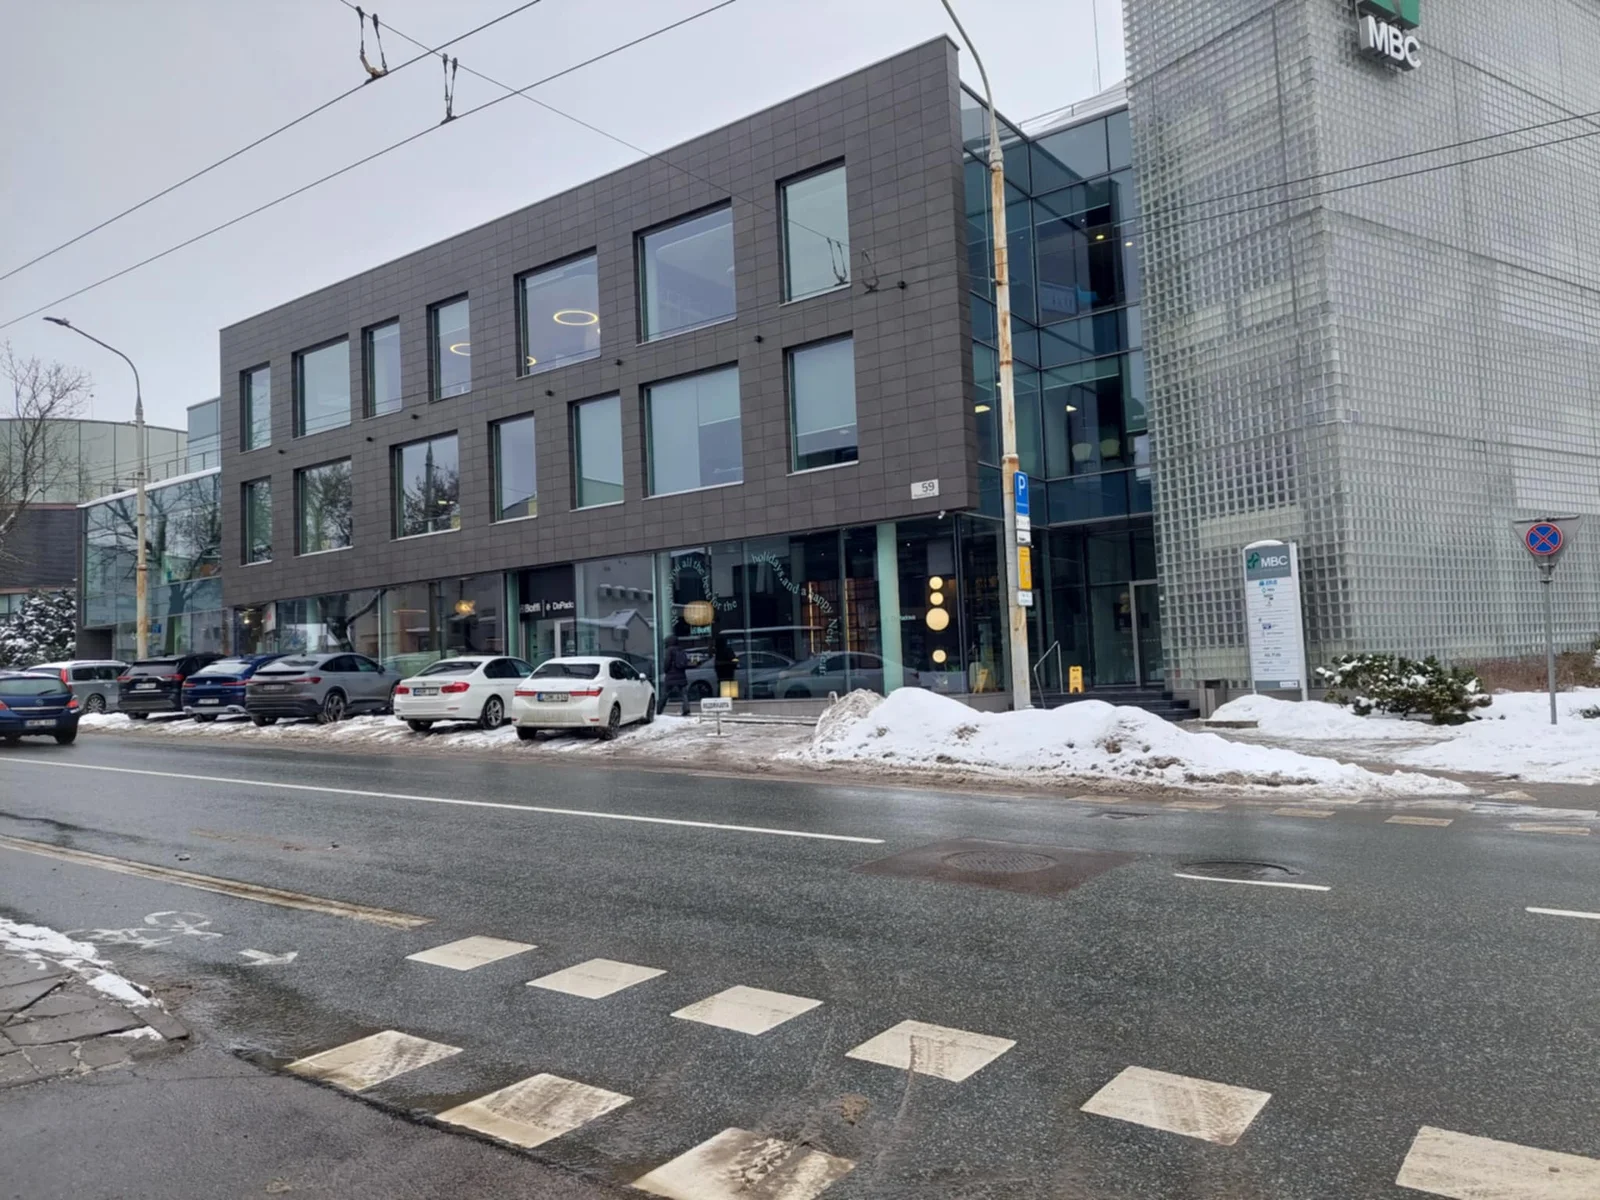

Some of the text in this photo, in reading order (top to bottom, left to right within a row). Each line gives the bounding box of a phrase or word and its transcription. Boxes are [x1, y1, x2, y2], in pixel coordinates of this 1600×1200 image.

[1367, 15, 1422, 68] MBC
[921, 481, 935, 493] 59
[1018, 475, 1026, 496] P
[1261, 555, 1288, 568] MBC
[682, 557, 692, 568] all
[693, 560, 705, 575] the
[702, 575, 713, 600] best
[724, 600, 738, 612] the
[782, 579, 799, 594] and
[801, 588, 807, 596] a
